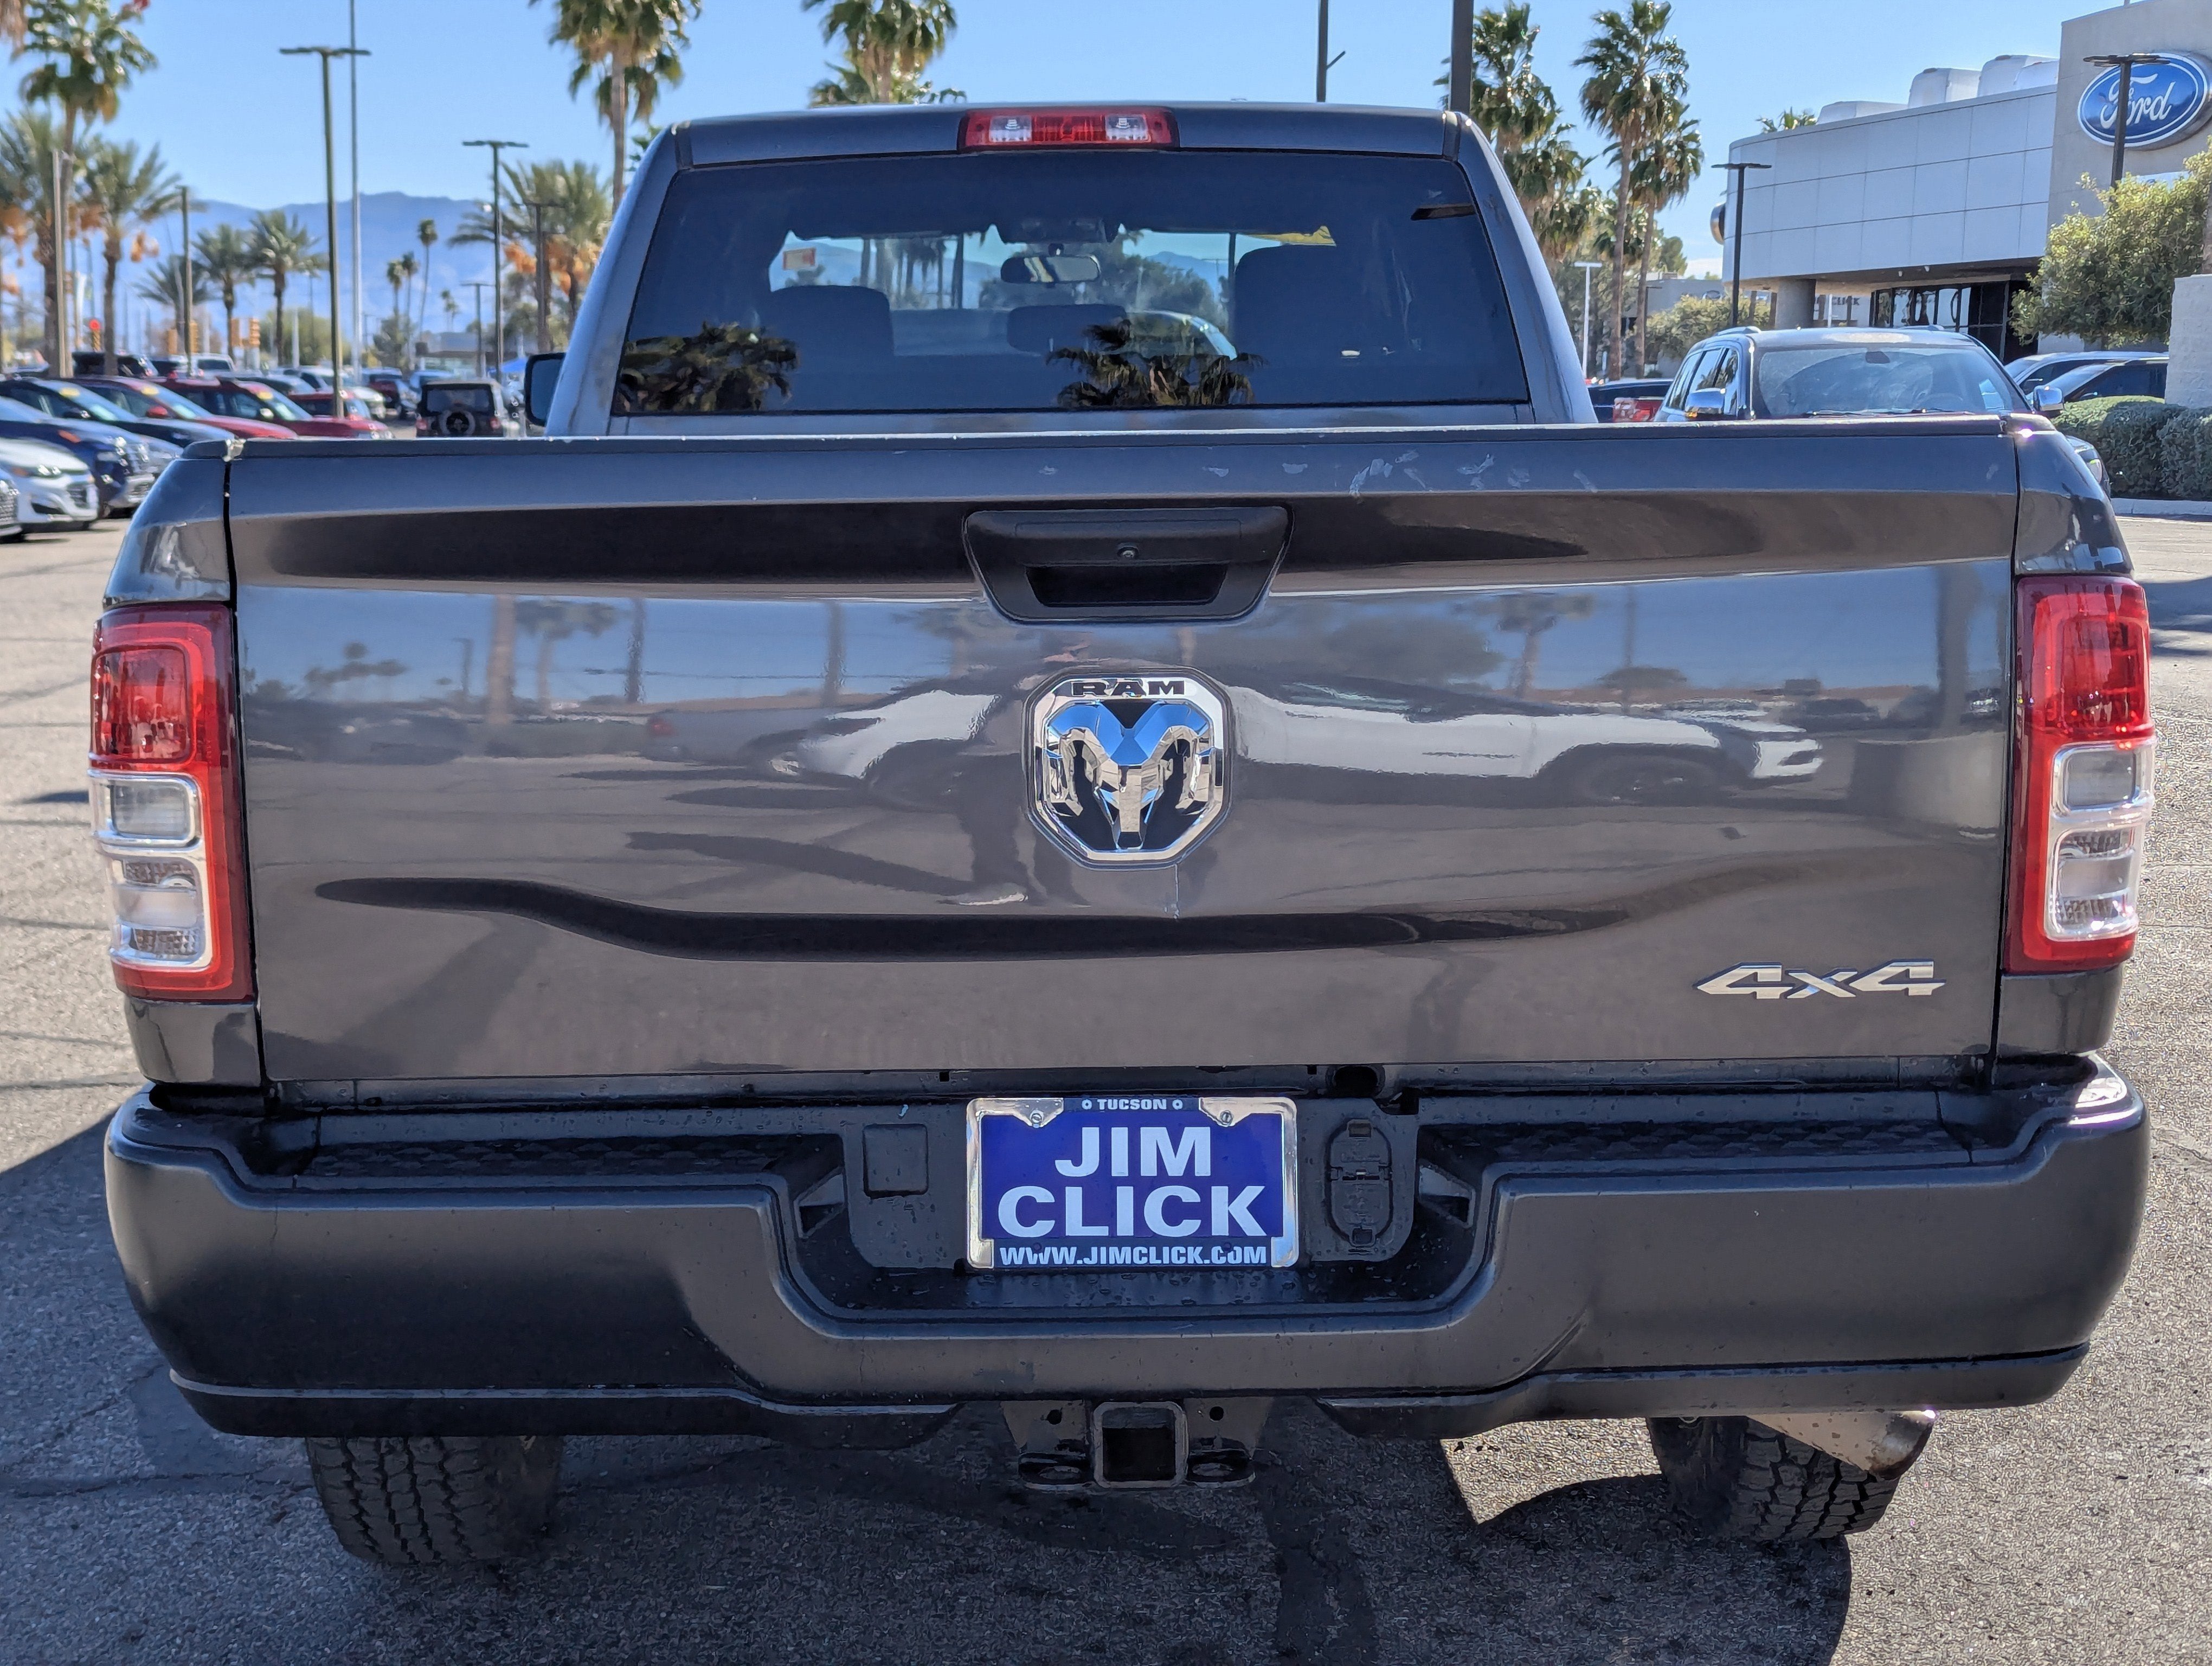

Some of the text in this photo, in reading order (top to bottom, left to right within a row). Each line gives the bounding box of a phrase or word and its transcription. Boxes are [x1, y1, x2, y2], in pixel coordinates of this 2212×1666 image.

[1071, 680, 1185, 696] RAM
[1694, 958, 1946, 999] 4x4
[1097, 1099, 1167, 1110] TUCSON
[1055, 1126, 1211, 1176] JIM
[998, 1186, 1267, 1237] CLICK
[1000, 1246, 1266, 1265] WWW.JIMCLICK.COM
